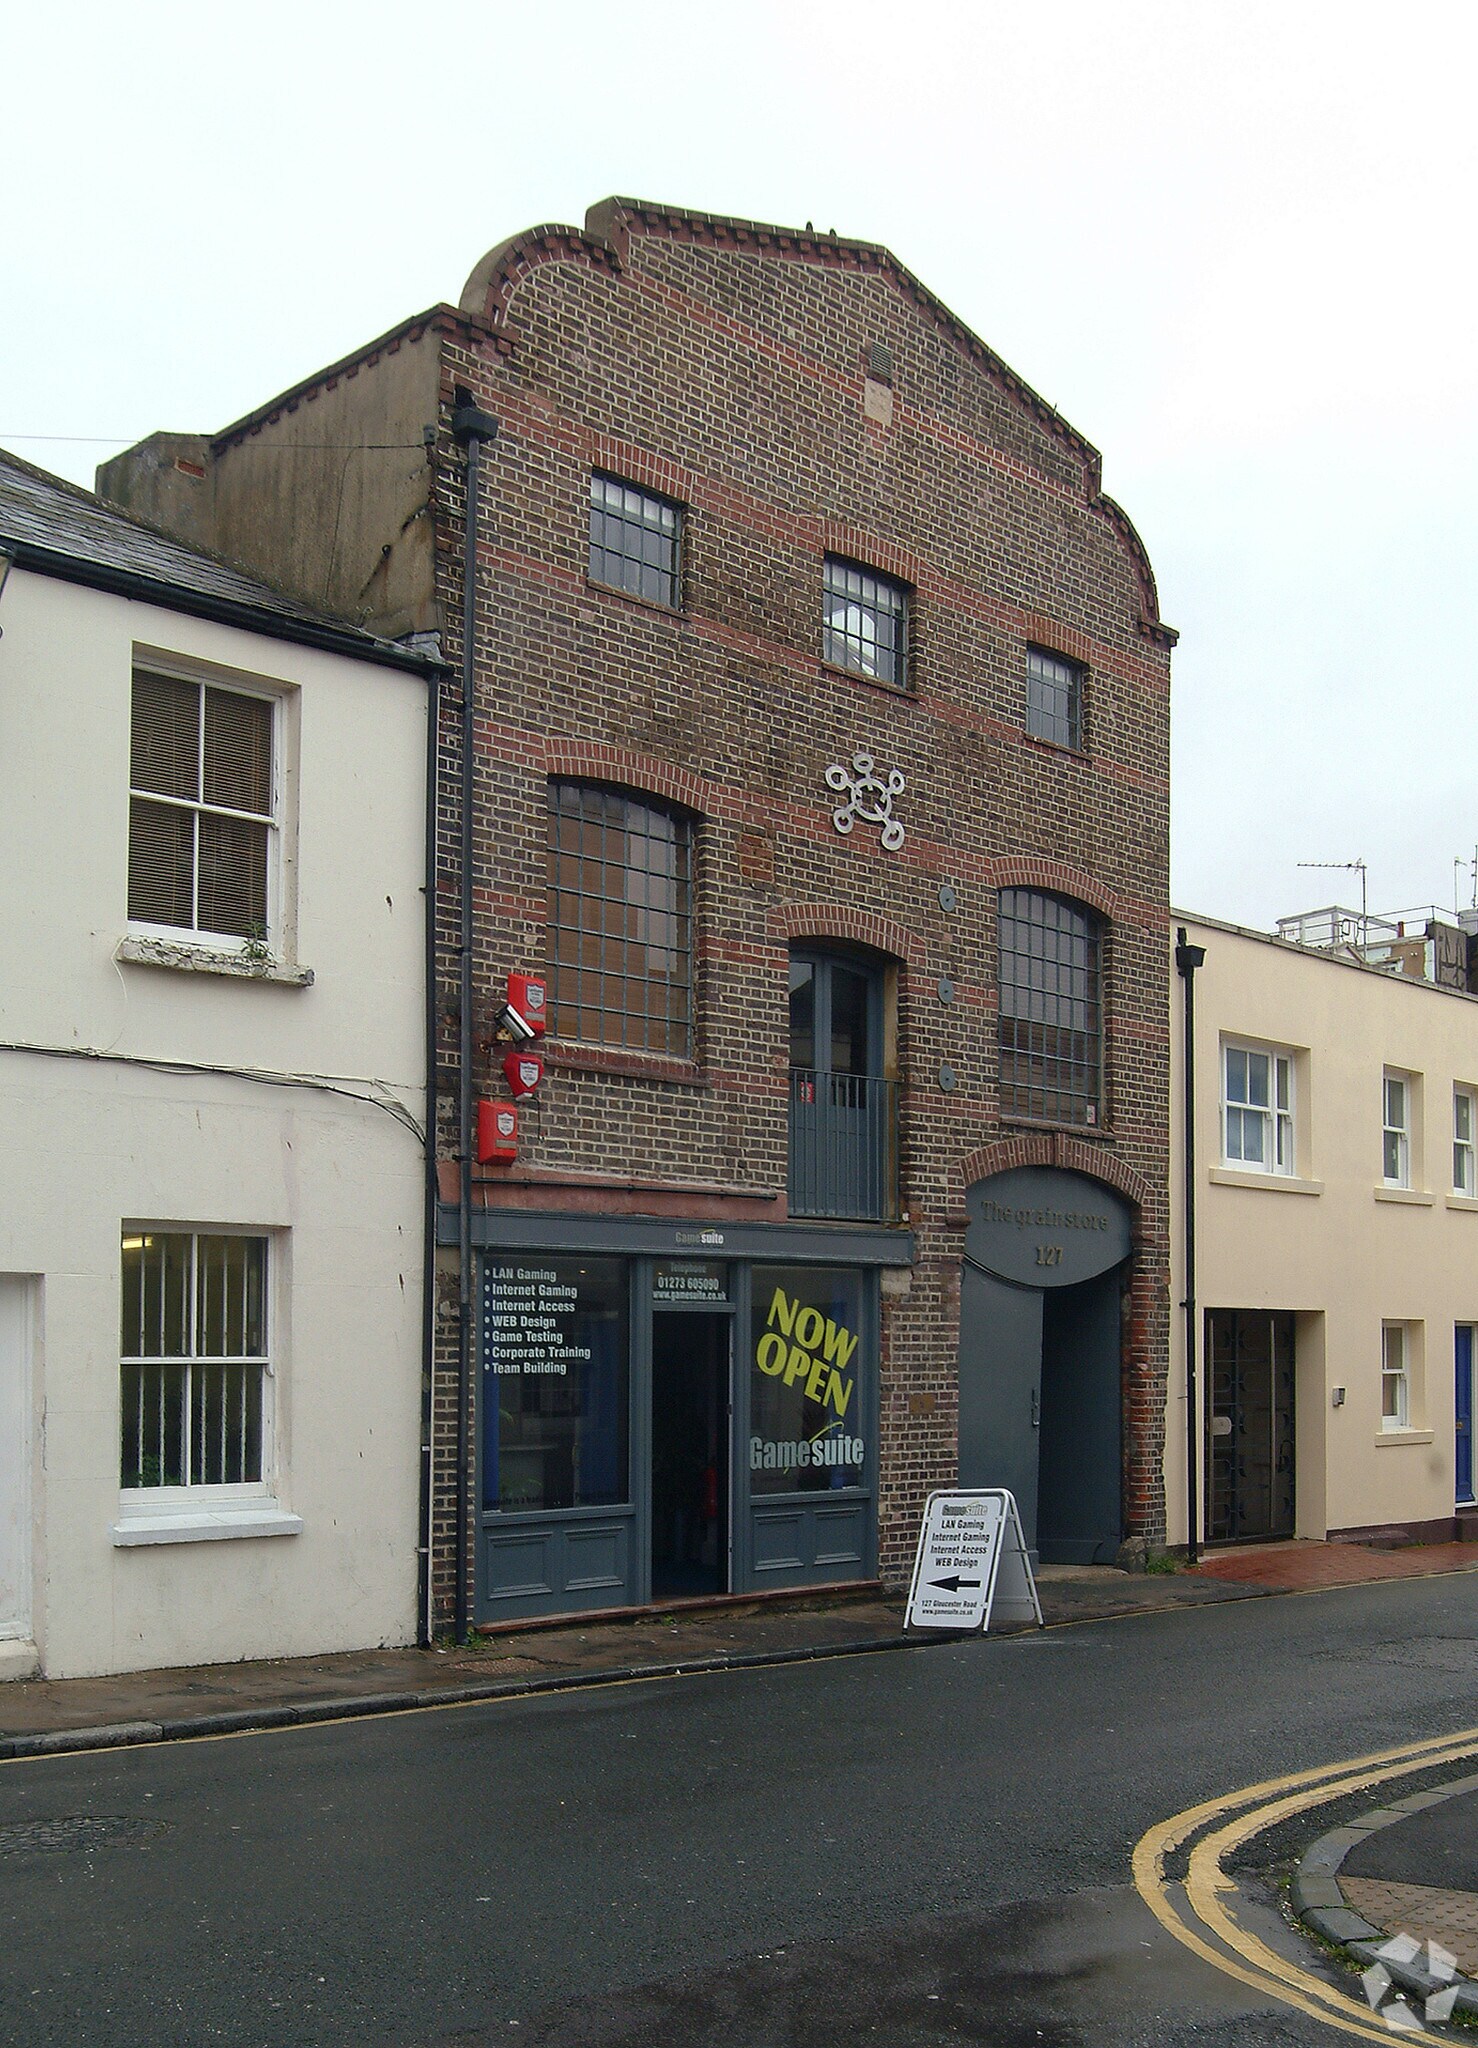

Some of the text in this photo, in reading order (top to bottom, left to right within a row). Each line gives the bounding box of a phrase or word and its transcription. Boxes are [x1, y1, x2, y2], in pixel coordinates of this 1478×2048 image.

[1036, 1246, 1063, 1266] 127
[492, 1267, 557, 1283] LAN Gaming
[658, 1276, 686, 1289] 01273
[492, 1283, 578, 1299] Internet Gaming
[492, 1299, 576, 1312] Internet Access
[492, 1315, 556, 1329] WEB Design
[766, 1286, 859, 1370] NOW
[492, 1331, 563, 1345] Game Testing
[492, 1346, 591, 1360] Corporate Training
[492, 1362, 567, 1375] Team Building
[756, 1332, 854, 1418] OPEN
[941, 1519, 985, 1531] LAN Gaming
[932, 1532, 990, 1543] Internet Gaming
[930, 1545, 987, 1555] Internet Access
[935, 1557, 978, 1568] WEB Design
[921, 1599, 932, 1607] 127
[963, 1600, 978, 1608] Road
